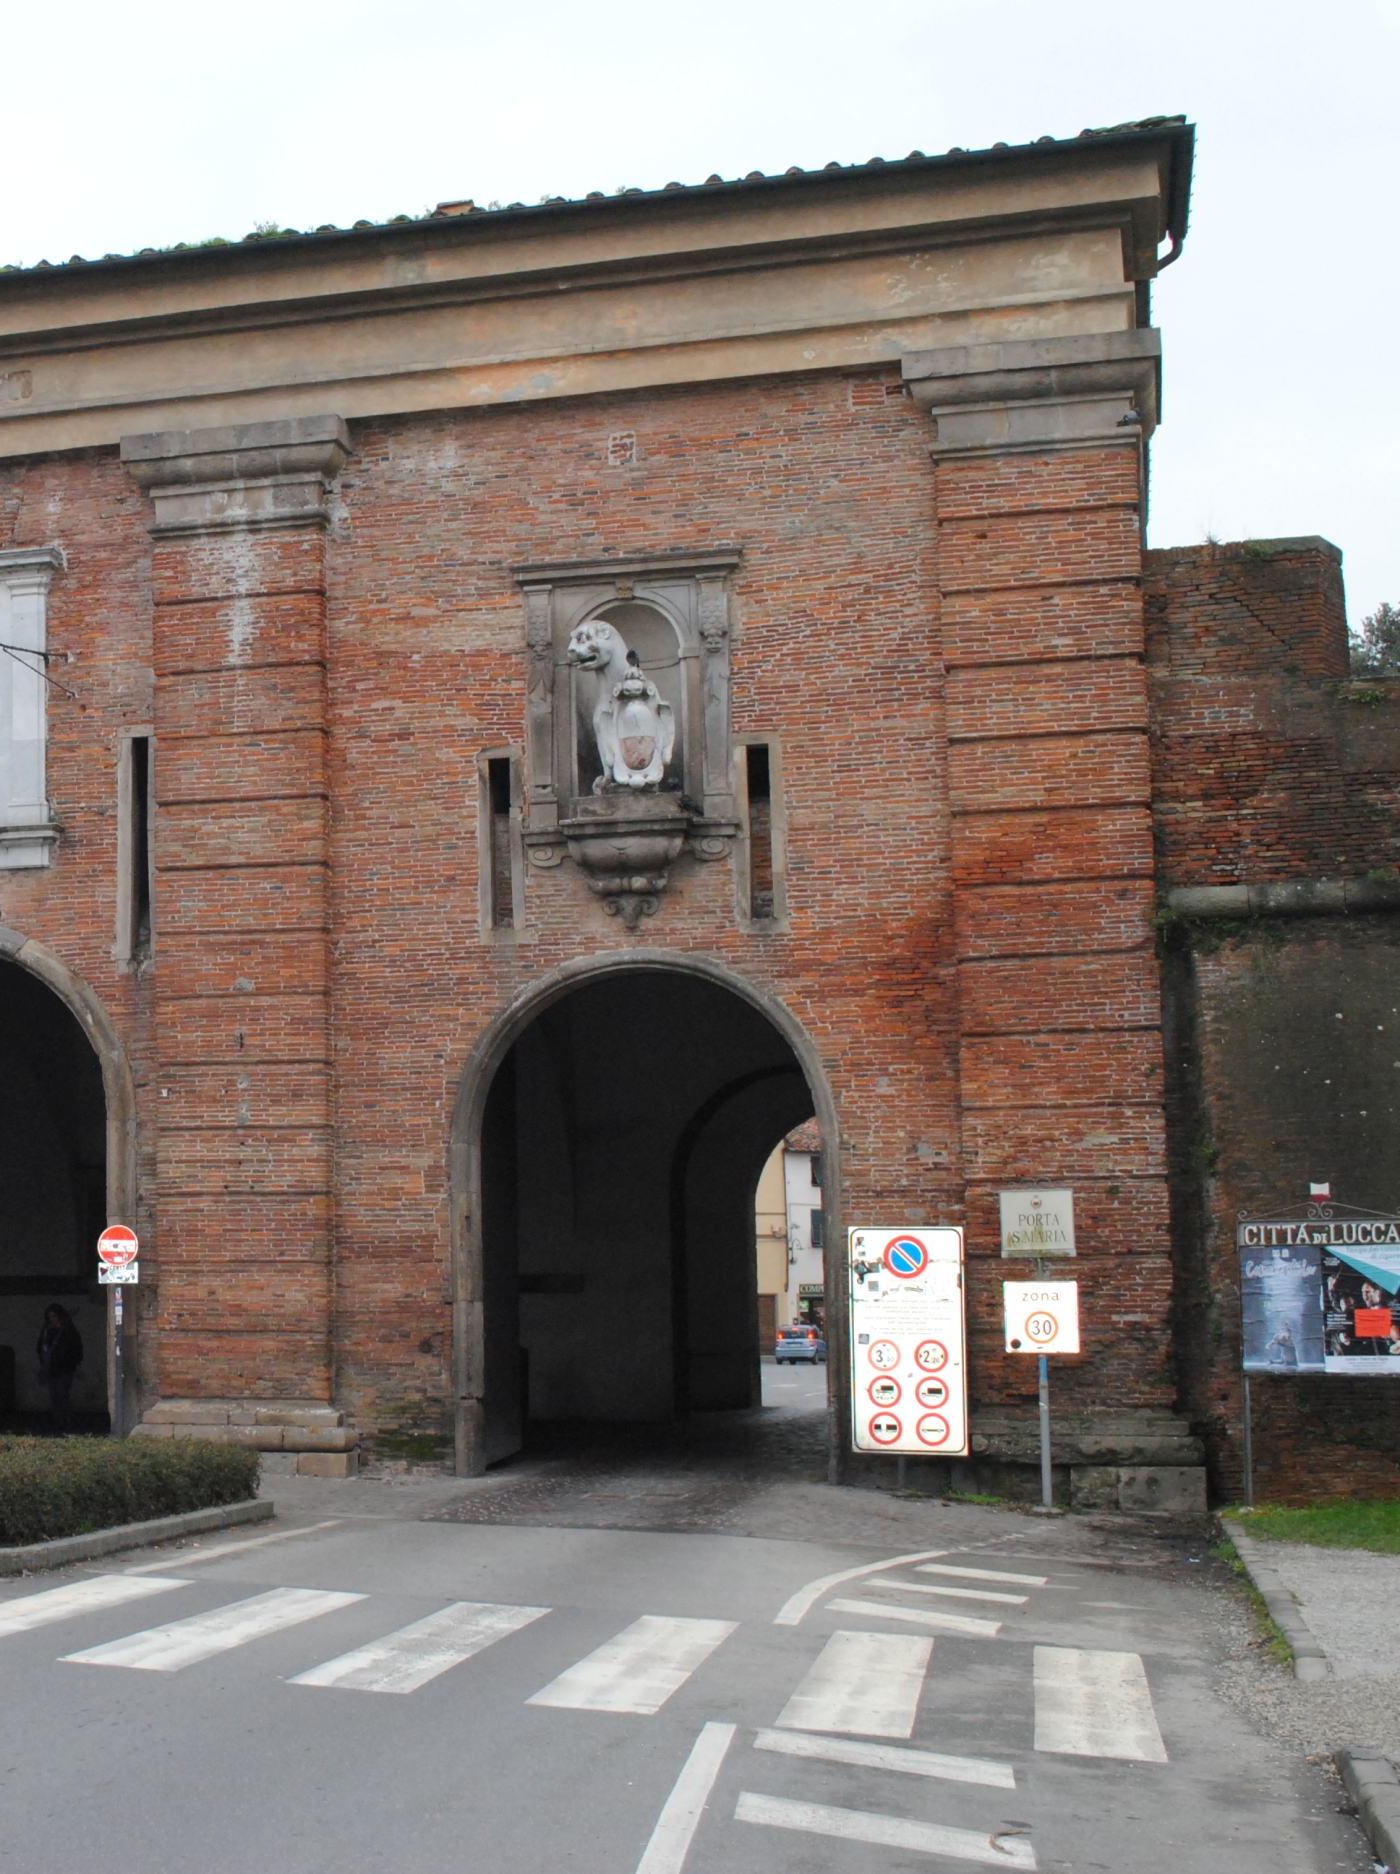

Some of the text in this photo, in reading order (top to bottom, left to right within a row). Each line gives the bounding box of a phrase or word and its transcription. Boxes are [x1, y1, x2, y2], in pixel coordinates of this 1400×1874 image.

[1018, 1213, 1060, 1226] PORTA
[1329, 1223, 1400, 1244] LUCCA
[1022, 1292, 1059, 1301] zona
[1032, 1319, 1052, 1335] 30
